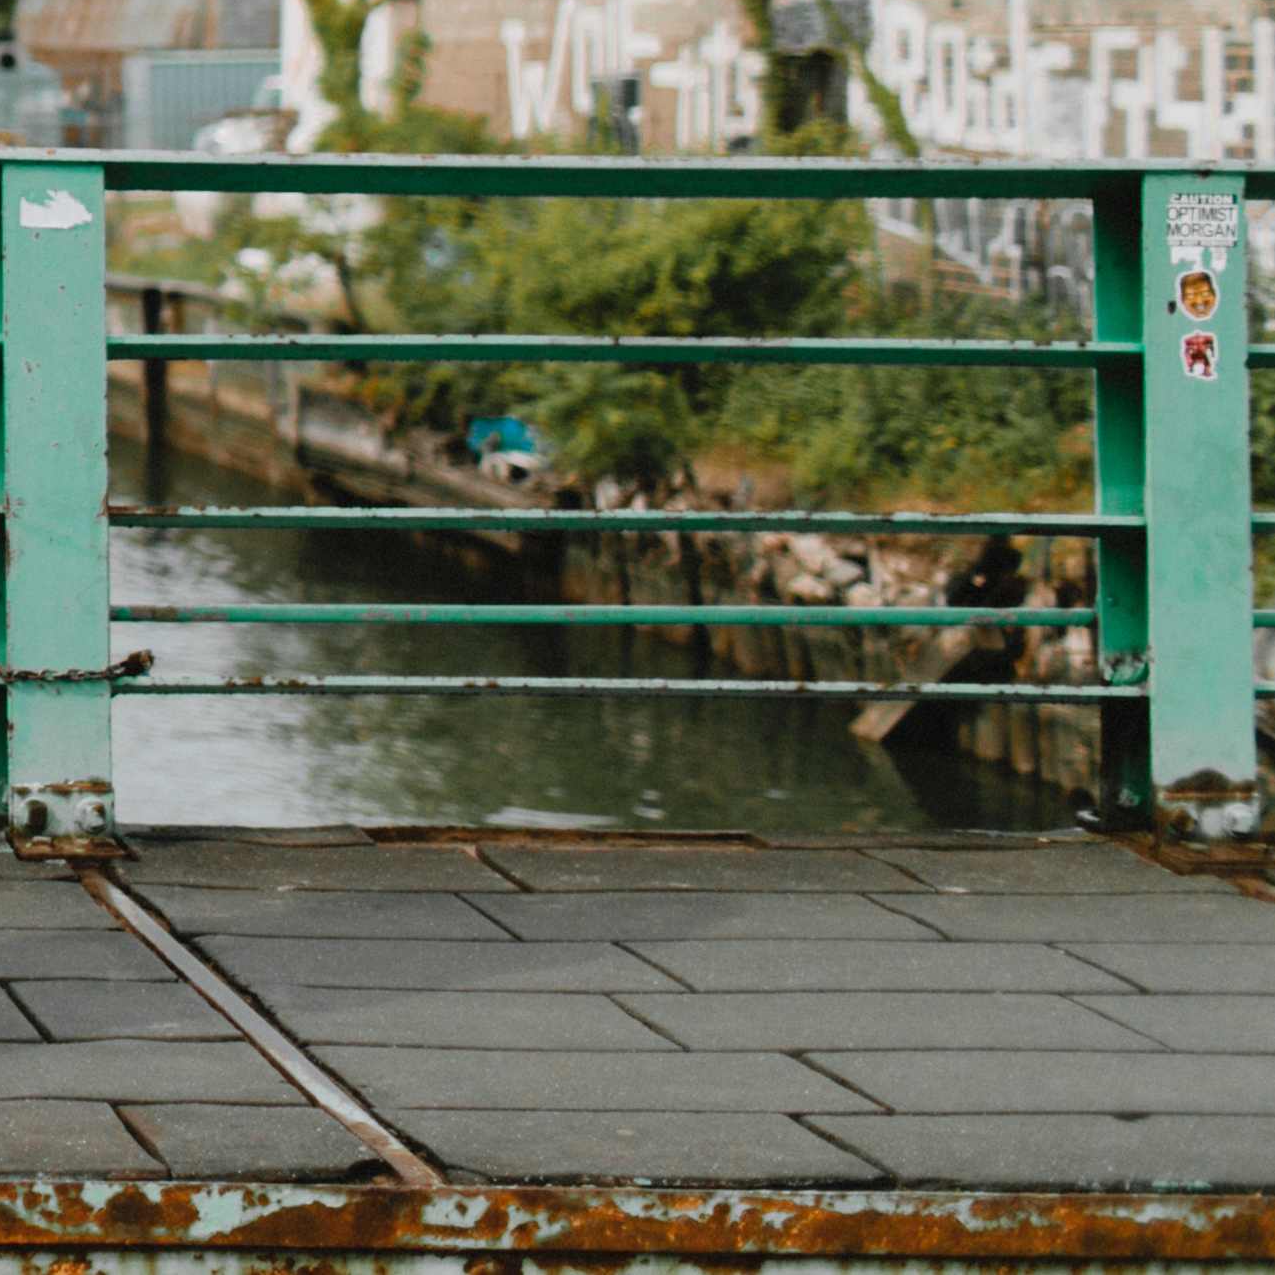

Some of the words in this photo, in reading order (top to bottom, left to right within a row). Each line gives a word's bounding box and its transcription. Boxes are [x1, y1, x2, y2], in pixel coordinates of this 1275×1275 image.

[1170, 193, 1234, 205] CAUTION
[1167, 207, 1235, 221] OPTIMIST
[1167, 223, 1236, 237] MORGAN
